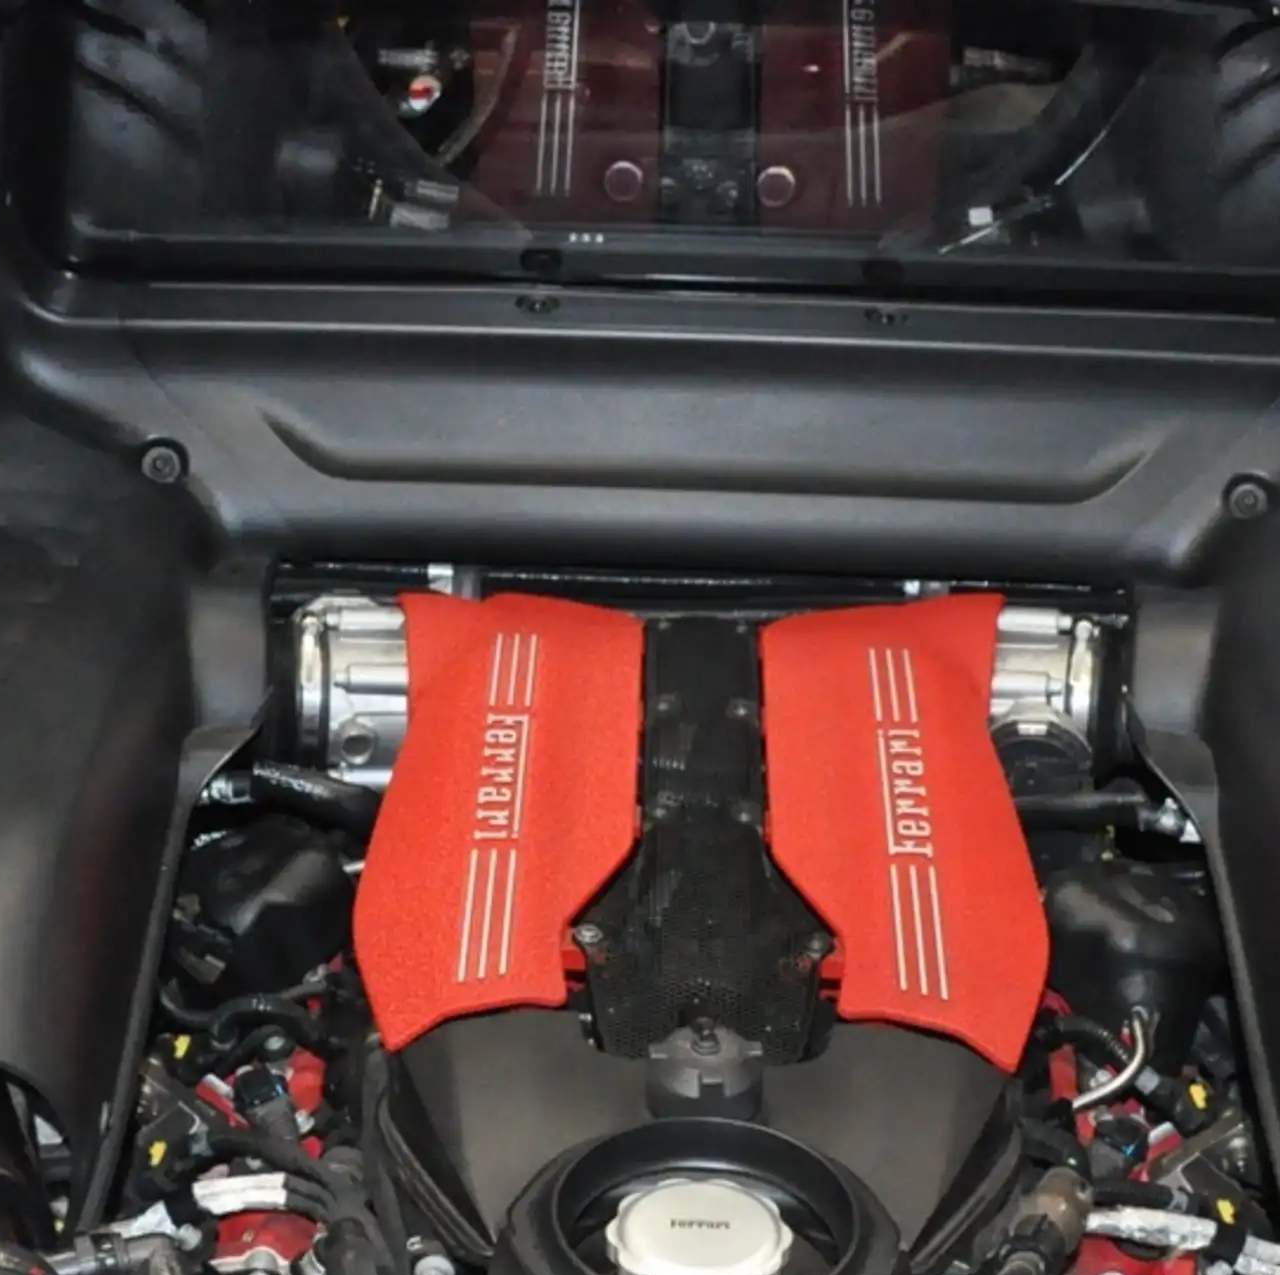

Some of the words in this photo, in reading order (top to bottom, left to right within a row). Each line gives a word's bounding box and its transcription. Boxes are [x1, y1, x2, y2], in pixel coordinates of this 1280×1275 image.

[473, 712, 530, 840] Ferrari
[876, 728, 934, 858] Ferrari
[670, 1218, 731, 1230] Ferrari
